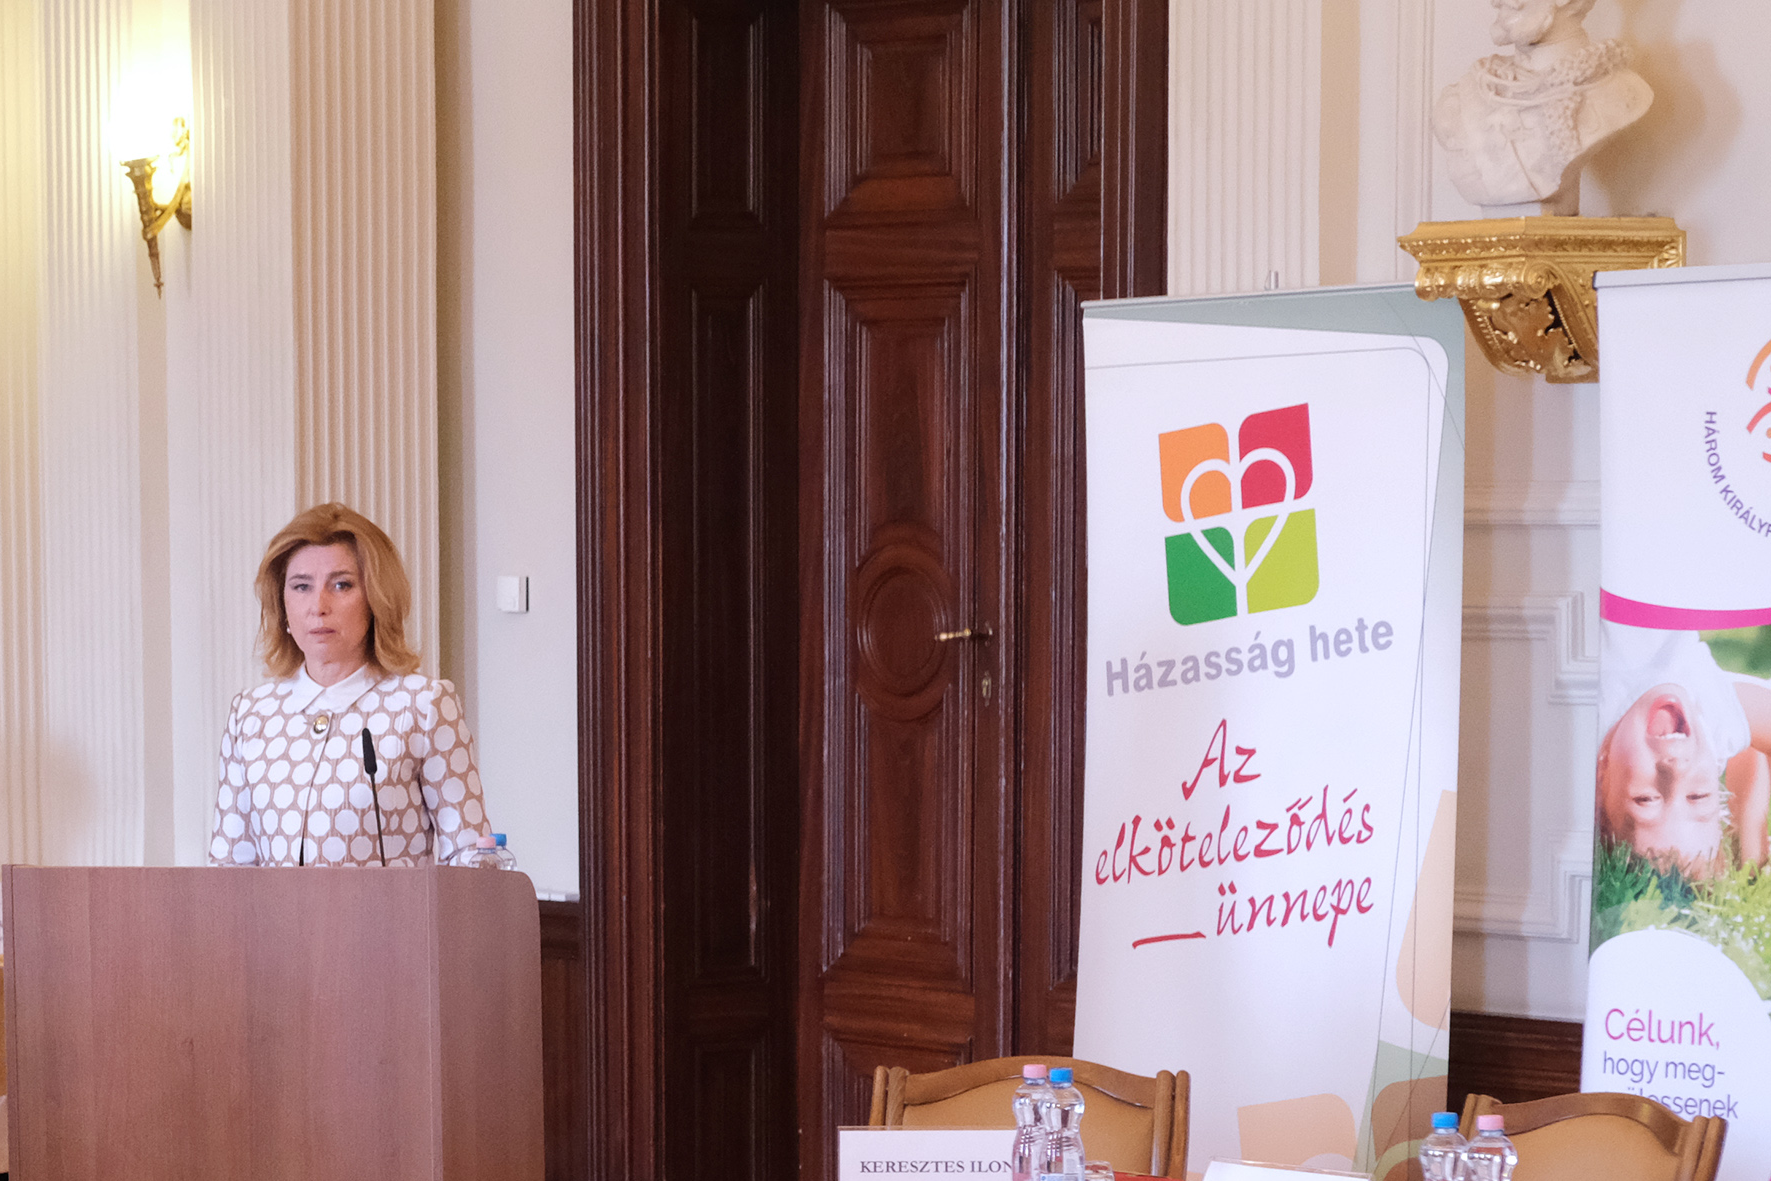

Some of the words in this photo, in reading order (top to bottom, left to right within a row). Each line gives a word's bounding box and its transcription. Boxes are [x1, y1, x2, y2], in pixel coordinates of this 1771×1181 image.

[1704, 411, 1726, 484] HÁROM
[1105, 630, 1295, 697] Házasság
[1308, 617, 1394, 662] hete
[1181, 718, 1261, 801] Az
[1095, 784, 1374, 885] elköteleződés
[1216, 877, 1374, 948] ünnepe
[1604, 1008, 1720, 1050] Célunk,
[1602, 1050, 1659, 1084] hogy
[1665, 1061, 1725, 1088] meg-
[859, 1160, 965, 1174] KERESZTES
